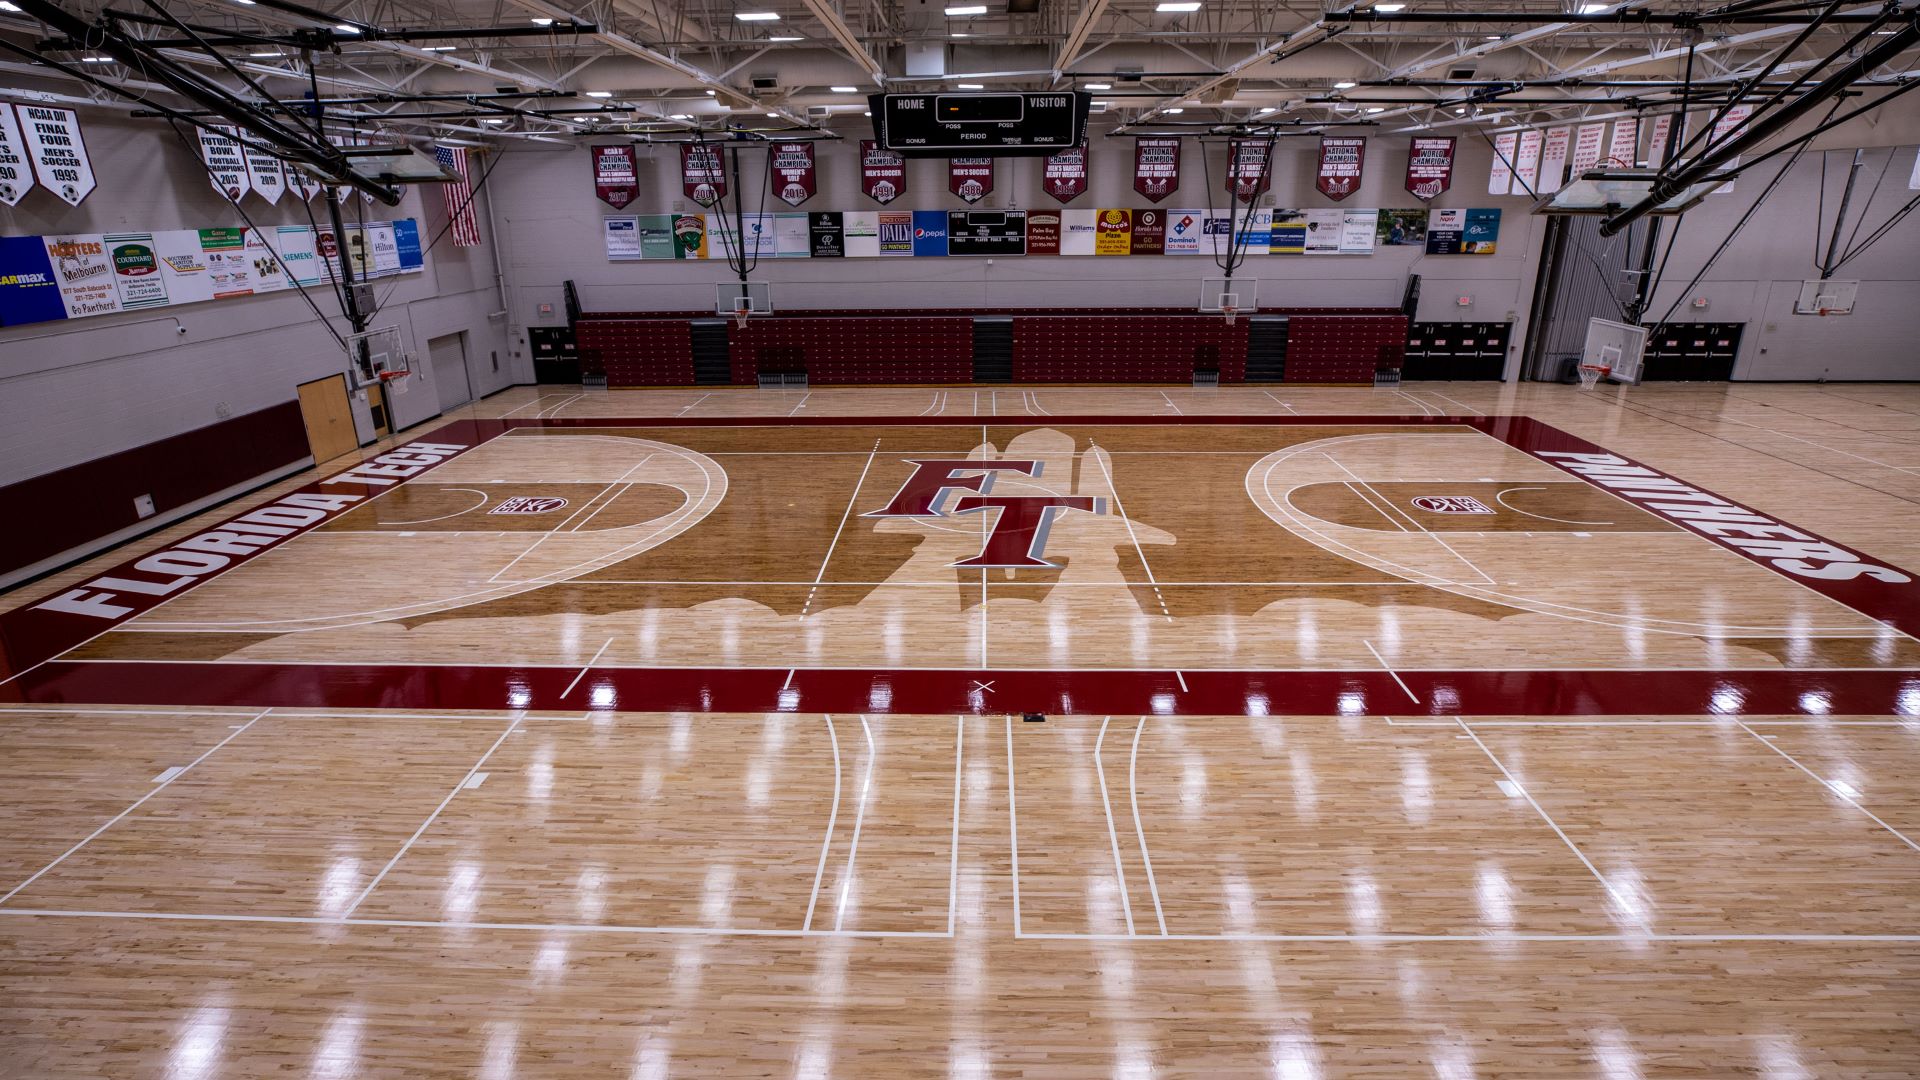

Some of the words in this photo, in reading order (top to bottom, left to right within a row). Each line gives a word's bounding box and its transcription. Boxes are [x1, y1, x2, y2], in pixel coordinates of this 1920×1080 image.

[897, 98, 925, 110] HOME
[1030, 97, 1066, 108] VISITOR
[28, 108, 53, 120] NCAA
[53, 110, 67, 122] DII
[35, 123, 69, 135] FINAL
[39, 134, 72, 146] FOUR
[202, 137, 238, 146] FUTURES
[44, 148, 74, 158] MEN'S
[210, 147, 235, 156] BOWL
[1143, 147, 1172, 155] NATIONAL
[599, 155, 629, 163] NATIONAL
[776, 152, 807, 160] NATIONAL
[1049, 156, 1084, 164] CHAMPION
[1140, 155, 1174, 163] CHAMPION
[1324, 154, 1359, 163] CHAMPION
[41, 157, 80, 166] SOCCER
[249, 158, 279, 166] WOMEN'S
[686, 161, 720, 169] CHAMPON
[774, 160, 812, 168] CHAMPIONS
[864, 158, 902, 166] CHAMPIONS
[952, 157, 991, 165] CHAMPIONS
[1412, 157, 1450, 165] CHAMPIONS
[208, 164, 245, 172] CHAMPIONS
[253, 166, 279, 174] ROWING
[599, 163, 632, 171] CHAMPION
[52, 169, 79, 182] 1993
[220, 174, 239, 184] 2013
[260, 176, 276, 186] 2019
[874, 186, 894, 196] 1991
[962, 186, 982, 196] 1988
[1145, 185, 1166, 194] 1988
[1416, 183, 1438, 193] 2020
[784, 189, 804, 198] 2019
[1100, 221, 1128, 229] marco's
[882, 224, 910, 242] DAILY
[925, 230, 945, 238] pepsi
[48, 242, 102, 257] HOOTERS
[374, 242, 394, 252] Hilton
[116, 256, 151, 264] COURTYARD
[284, 252, 313, 262] SIEMENS
[83, 258, 90, 266] of
[62, 264, 107, 282] Melbourne
[72, 305, 81, 314] Go
[83, 300, 116, 313] Panthers!
[1532, 450, 1912, 584] PANTHERS
[26, 493, 366, 620] FLORIDA
[326, 442, 469, 486] TECH
